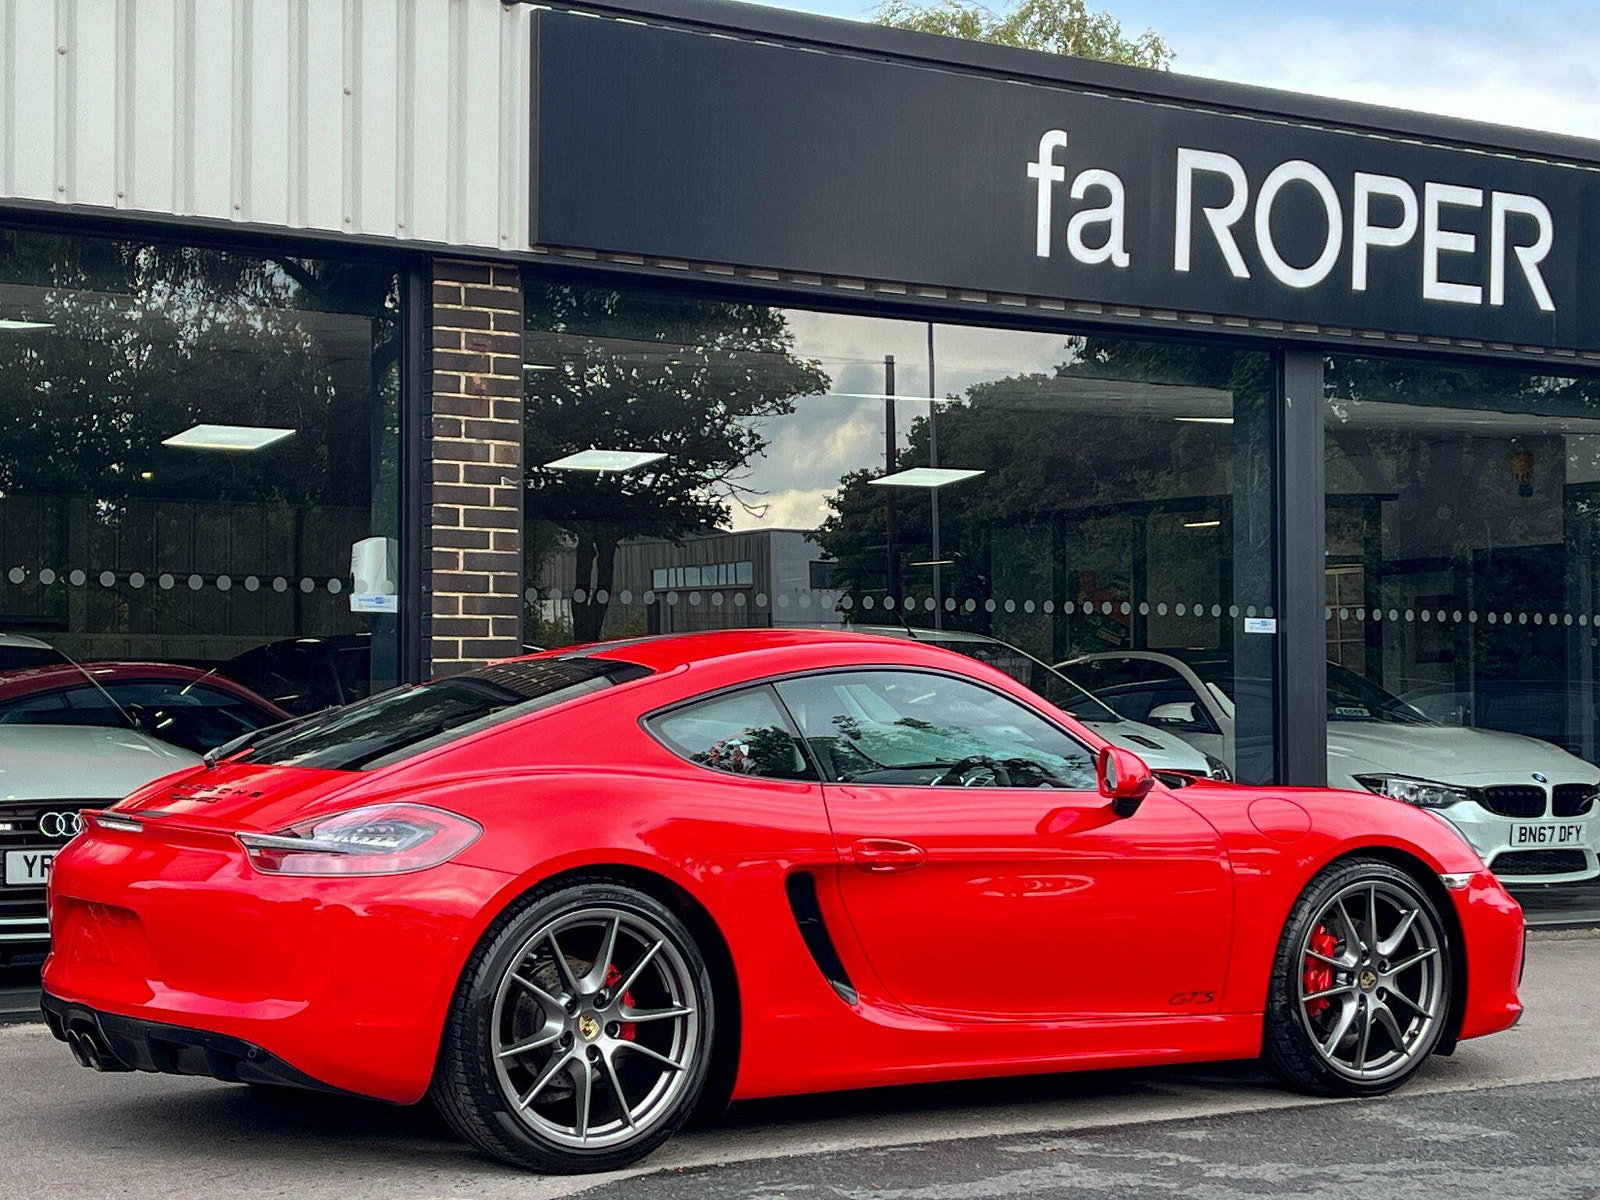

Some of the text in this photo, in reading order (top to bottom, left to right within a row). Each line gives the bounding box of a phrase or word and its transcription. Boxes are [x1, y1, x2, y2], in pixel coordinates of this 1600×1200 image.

[1027, 130, 1556, 311] fa ROPER
[1518, 824, 1582, 843] BN67 DFY
[1168, 991, 1216, 1006] GTS
